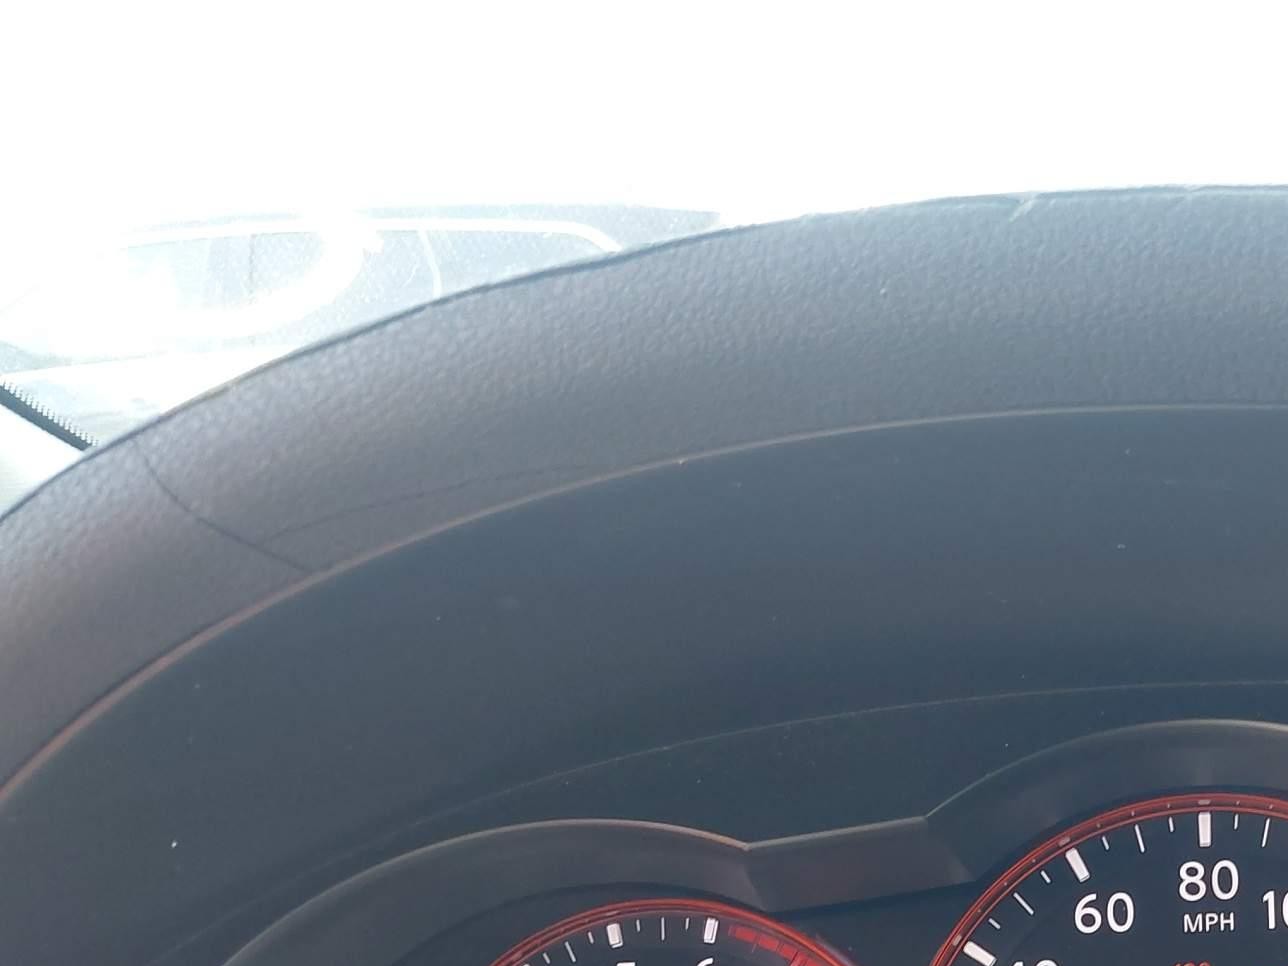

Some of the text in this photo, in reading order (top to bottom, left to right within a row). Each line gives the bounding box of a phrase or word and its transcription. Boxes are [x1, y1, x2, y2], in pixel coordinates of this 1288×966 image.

[1179, 859, 1240, 902] 80
[1074, 892, 1135, 934] 60
[1183, 912, 1235, 933] MPH
